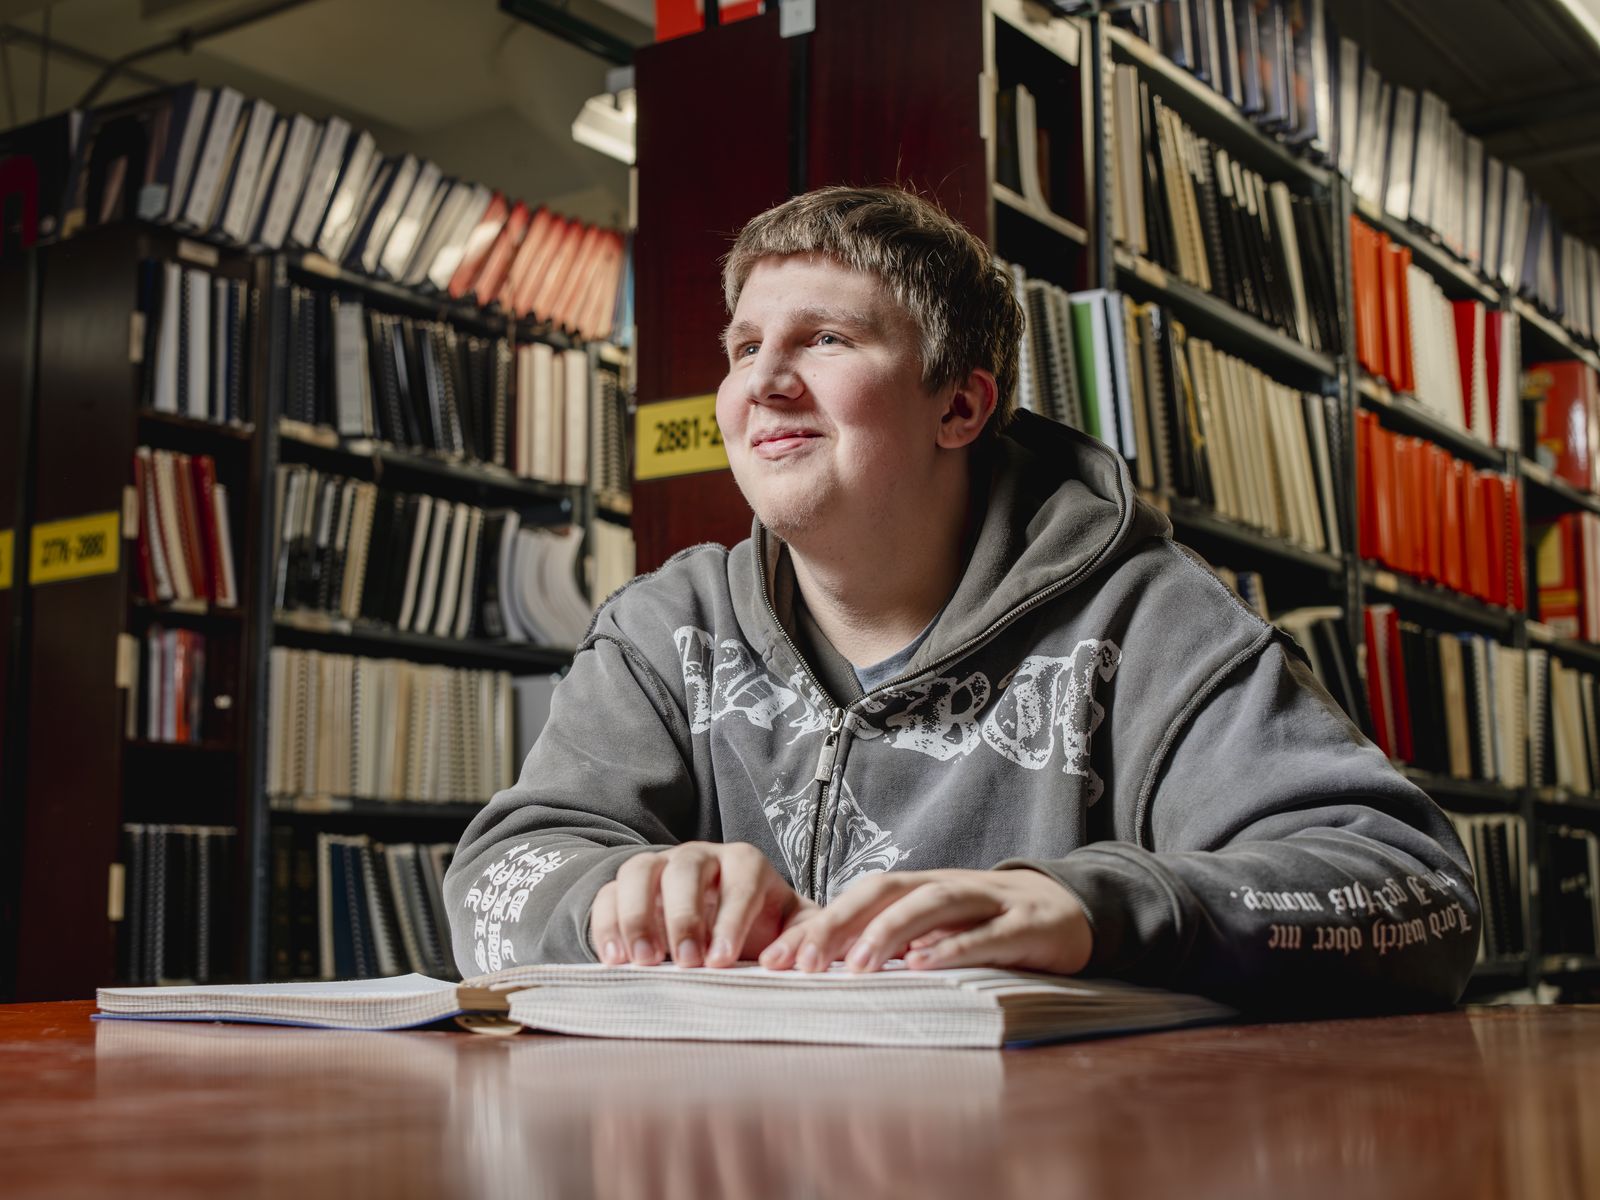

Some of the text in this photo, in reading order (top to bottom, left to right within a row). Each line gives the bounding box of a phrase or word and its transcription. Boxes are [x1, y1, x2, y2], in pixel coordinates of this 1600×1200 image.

[1229, 885, 1325, 912] money.
[1374, 877, 1409, 914] get
[1267, 901, 1472, 956] Lord watch over me
